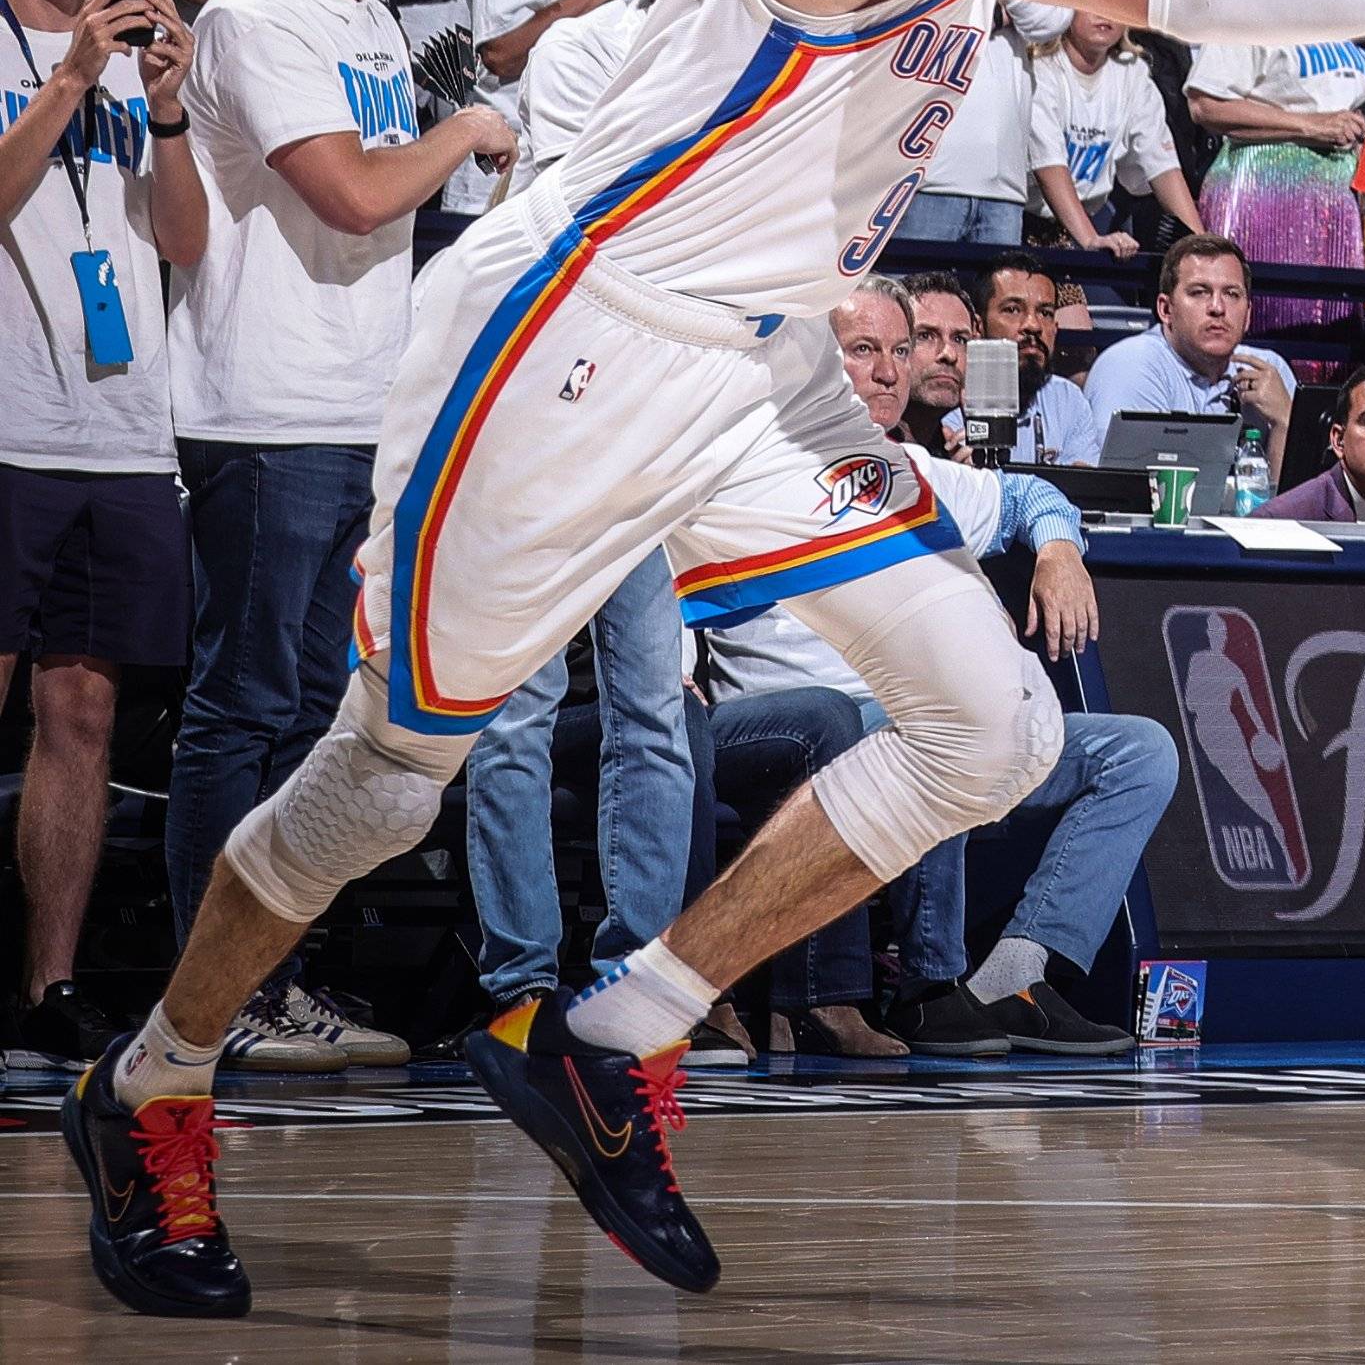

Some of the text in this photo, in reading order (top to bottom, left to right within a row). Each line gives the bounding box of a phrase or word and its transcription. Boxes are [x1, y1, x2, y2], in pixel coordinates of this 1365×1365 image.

[838, 166, 926, 278] 9
[830, 461, 880, 517] OKC
[1221, 825, 1275, 870] NBA
